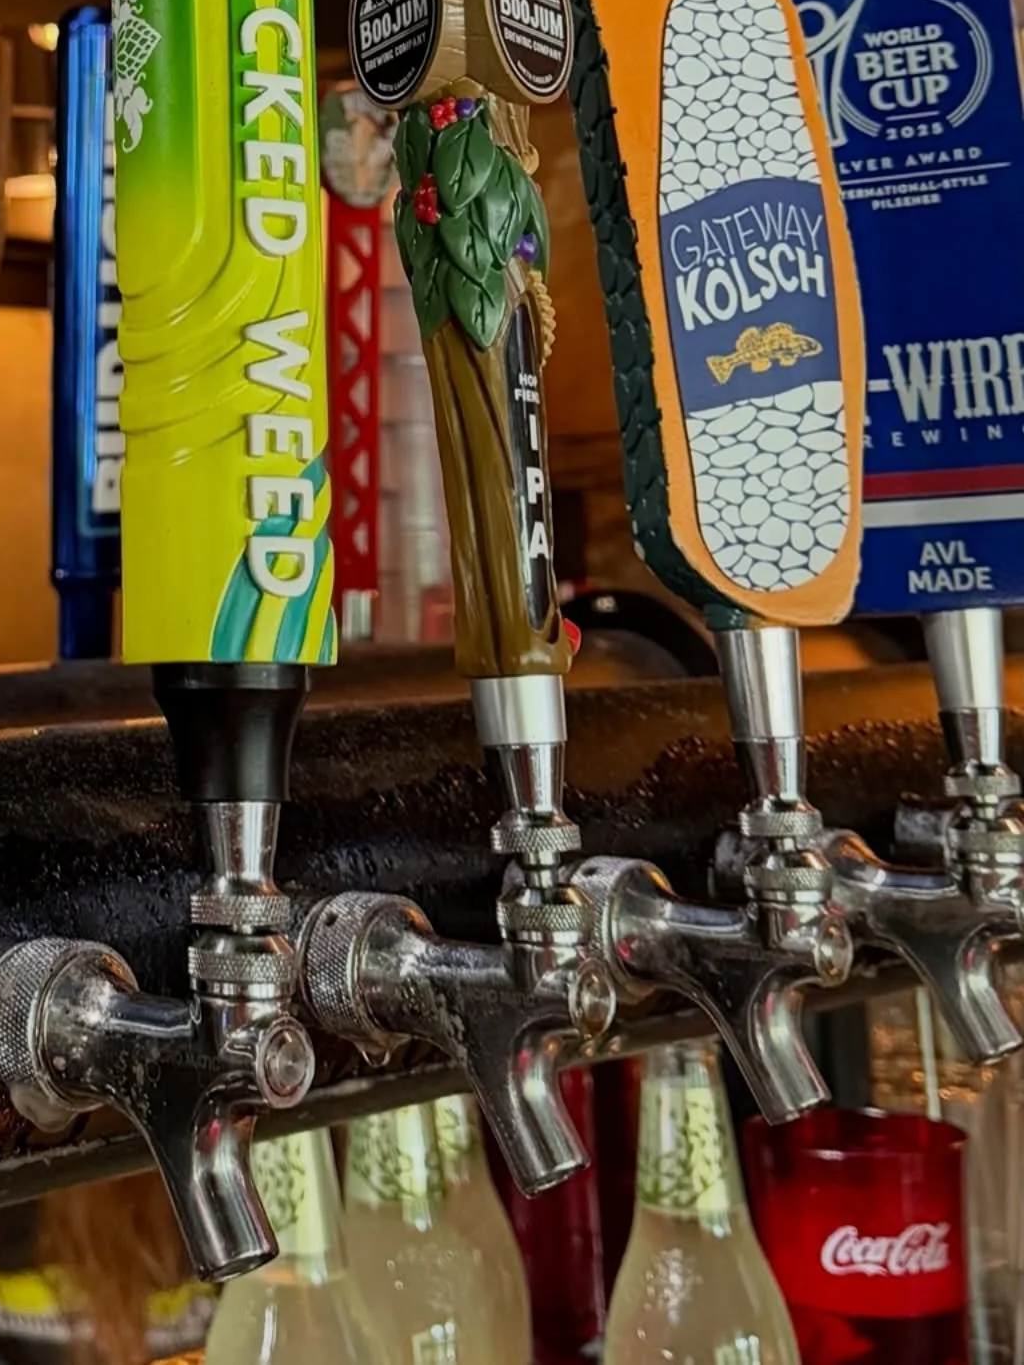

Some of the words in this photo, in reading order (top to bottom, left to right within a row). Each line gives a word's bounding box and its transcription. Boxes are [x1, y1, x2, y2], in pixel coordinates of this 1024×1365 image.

[864, 23, 943, 50] WORLD
[853, 41, 959, 82] BEER
[869, 73, 950, 111] CUP
[885, 121, 944, 141] 2025
[904, 146, 982, 168] AWARD
[671, 201, 823, 273] GATEWAY
[675, 242, 826, 332] KÖLSCH
[243, 309, 314, 598] WEED
[526, 414, 549, 560] IPA
[919, 540, 975, 565] AVL
[908, 566, 994, 593] MADE
[820, 1221, 950, 1276] Coca-Cola
